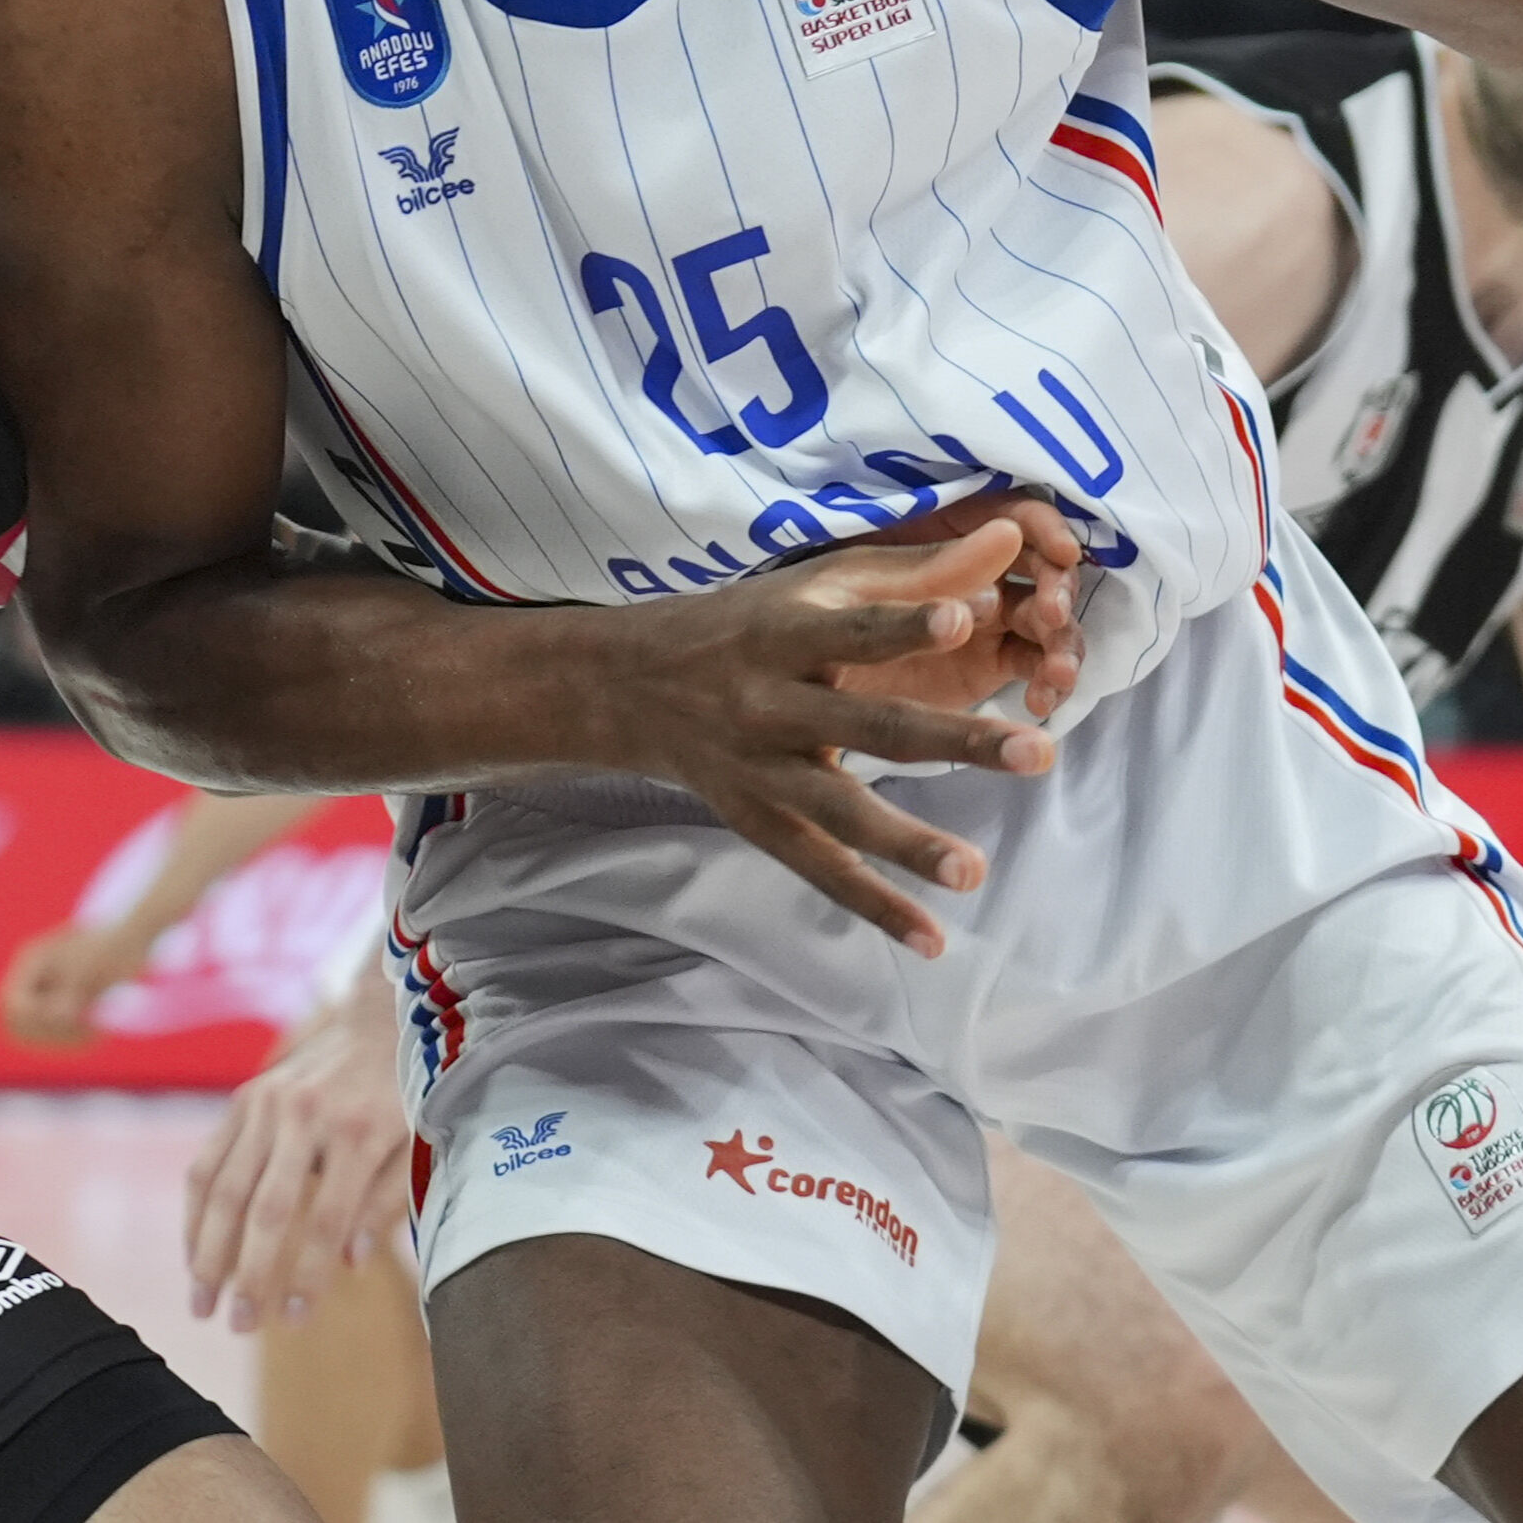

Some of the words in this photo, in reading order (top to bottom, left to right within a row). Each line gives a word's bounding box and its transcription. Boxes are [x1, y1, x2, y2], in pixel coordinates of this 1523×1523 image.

[359, 31, 434, 70] ANADOLU
[374, 49, 428, 80] EFES
[393, 76, 419, 94] 1976
[396, 179, 475, 215] bilcee
[580, 225, 829, 456] 25
[493, 1142, 572, 1177] bilcee
[766, 1168, 919, 1254] corendon
